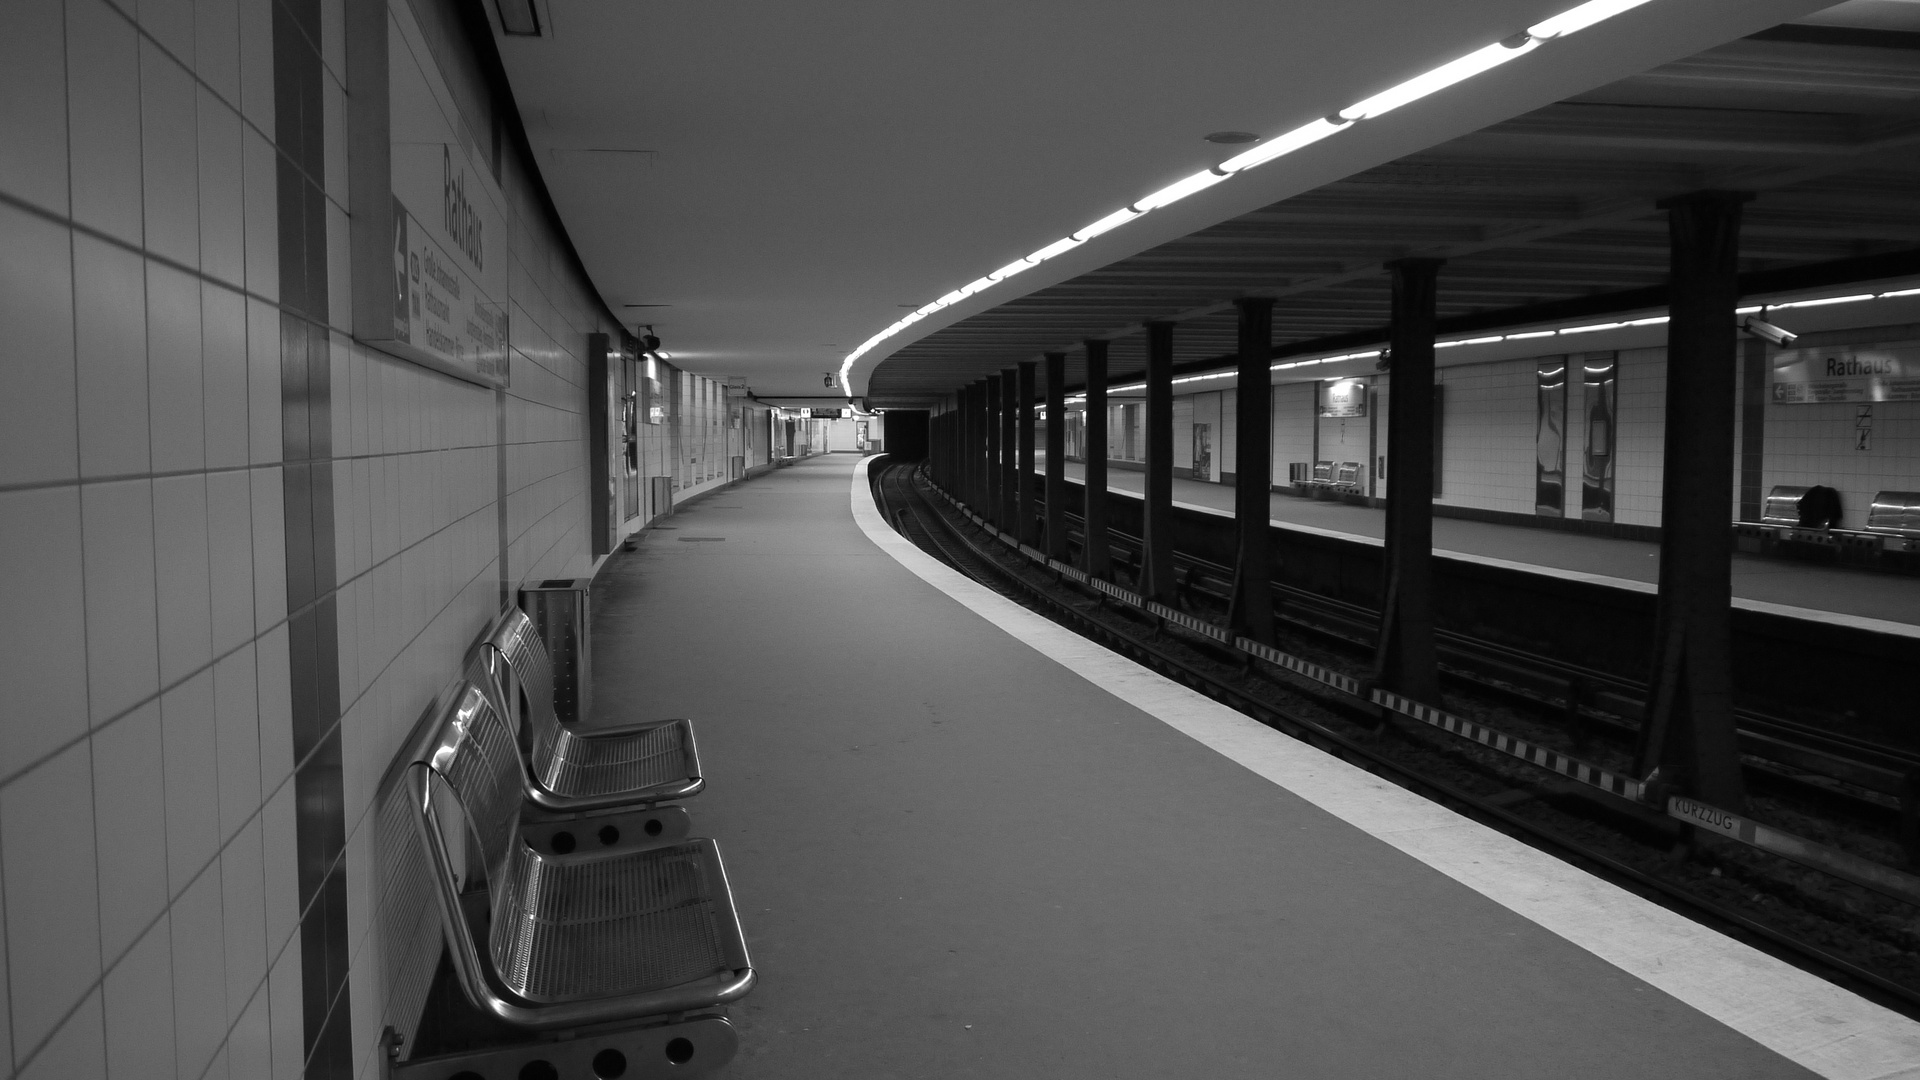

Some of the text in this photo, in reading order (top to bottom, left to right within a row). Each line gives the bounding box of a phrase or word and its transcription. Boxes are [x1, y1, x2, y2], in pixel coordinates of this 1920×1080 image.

[444, 142, 483, 272] Rathaus
[1827, 356, 1892, 376] Rathaus
[1675, 797, 1732, 829] KURZZUG
